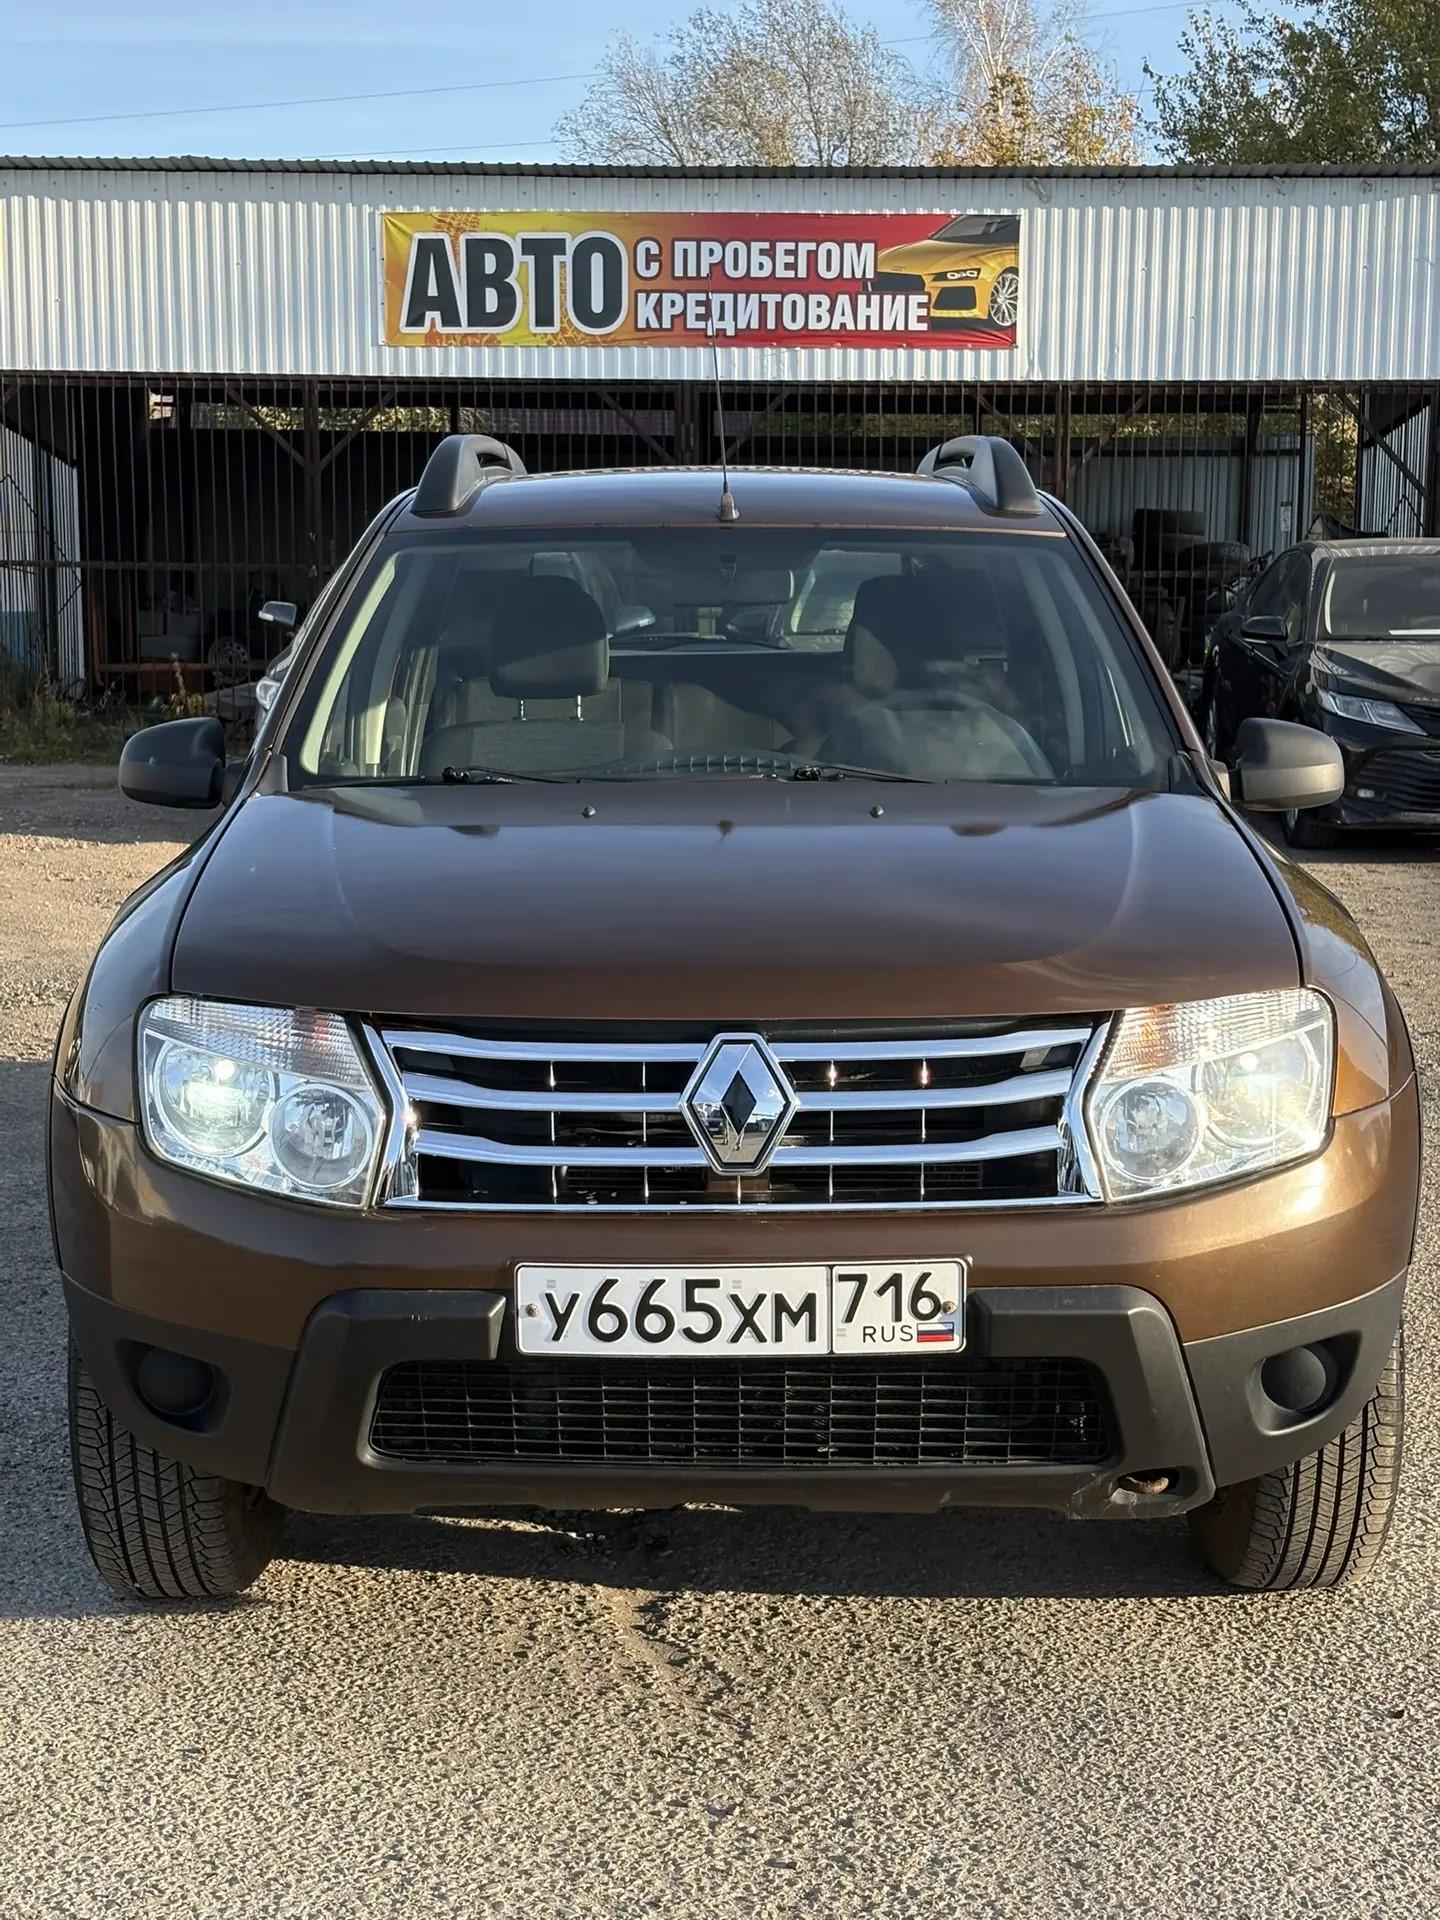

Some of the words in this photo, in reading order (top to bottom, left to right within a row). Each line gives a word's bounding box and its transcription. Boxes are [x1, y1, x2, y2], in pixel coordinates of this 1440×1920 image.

[636, 240, 660, 277] С
[674, 242, 875, 279] ПРОБЕГОМ
[402, 238, 626, 332] АВТО
[636, 293, 929, 336] КРЕДИТОВАНИЕ
[838, 1272, 943, 1324] 716
[862, 1325, 914, 1343] RUS
